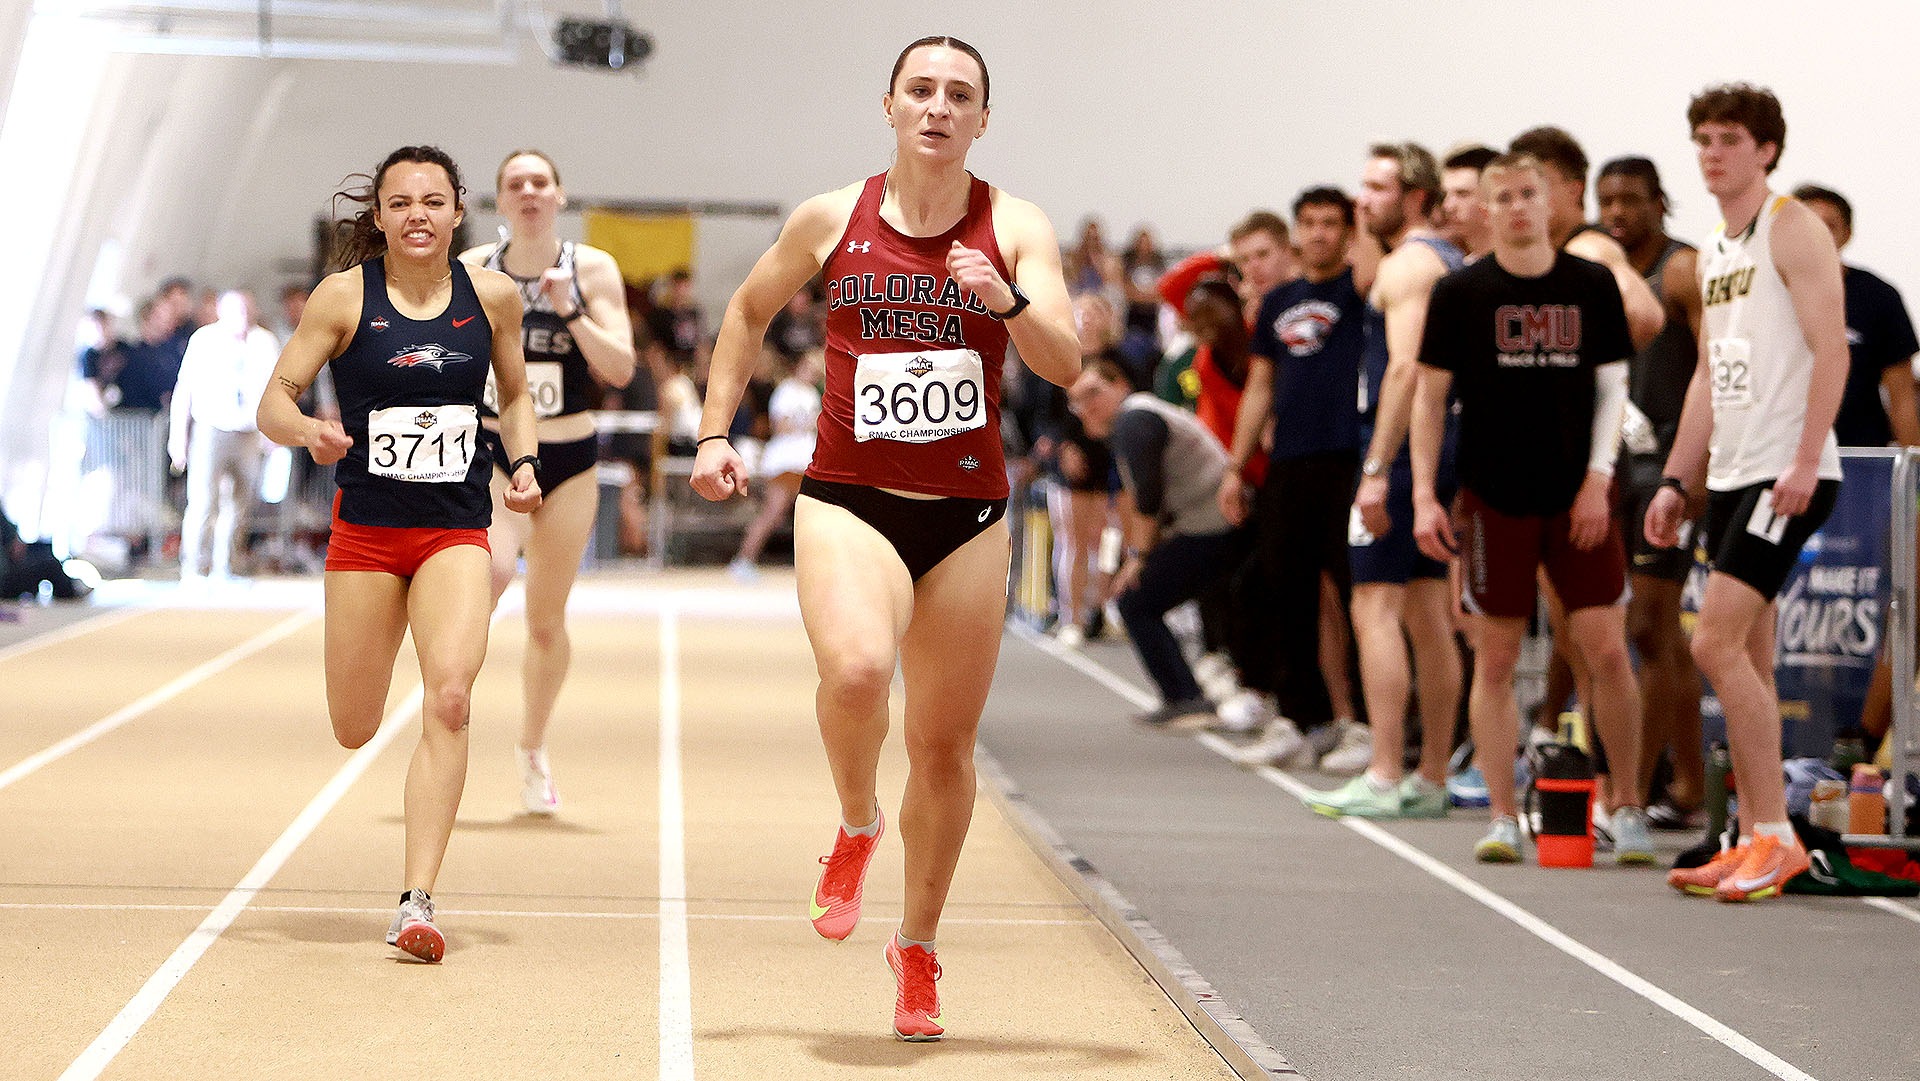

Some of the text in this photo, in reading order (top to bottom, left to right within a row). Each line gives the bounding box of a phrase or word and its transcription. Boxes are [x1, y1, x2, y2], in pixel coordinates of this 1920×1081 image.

[828, 273, 1001, 321] COLORAD
[860, 308, 966, 346] MESA
[1495, 304, 1582, 352] CMU
[860, 379, 979, 426] 3609
[374, 429, 468, 469] 3711
[868, 430, 898, 439] RMAC
[899, 426, 972, 438] CHAMPIONSHIP
[1808, 565, 1881, 594] MAKE IT
